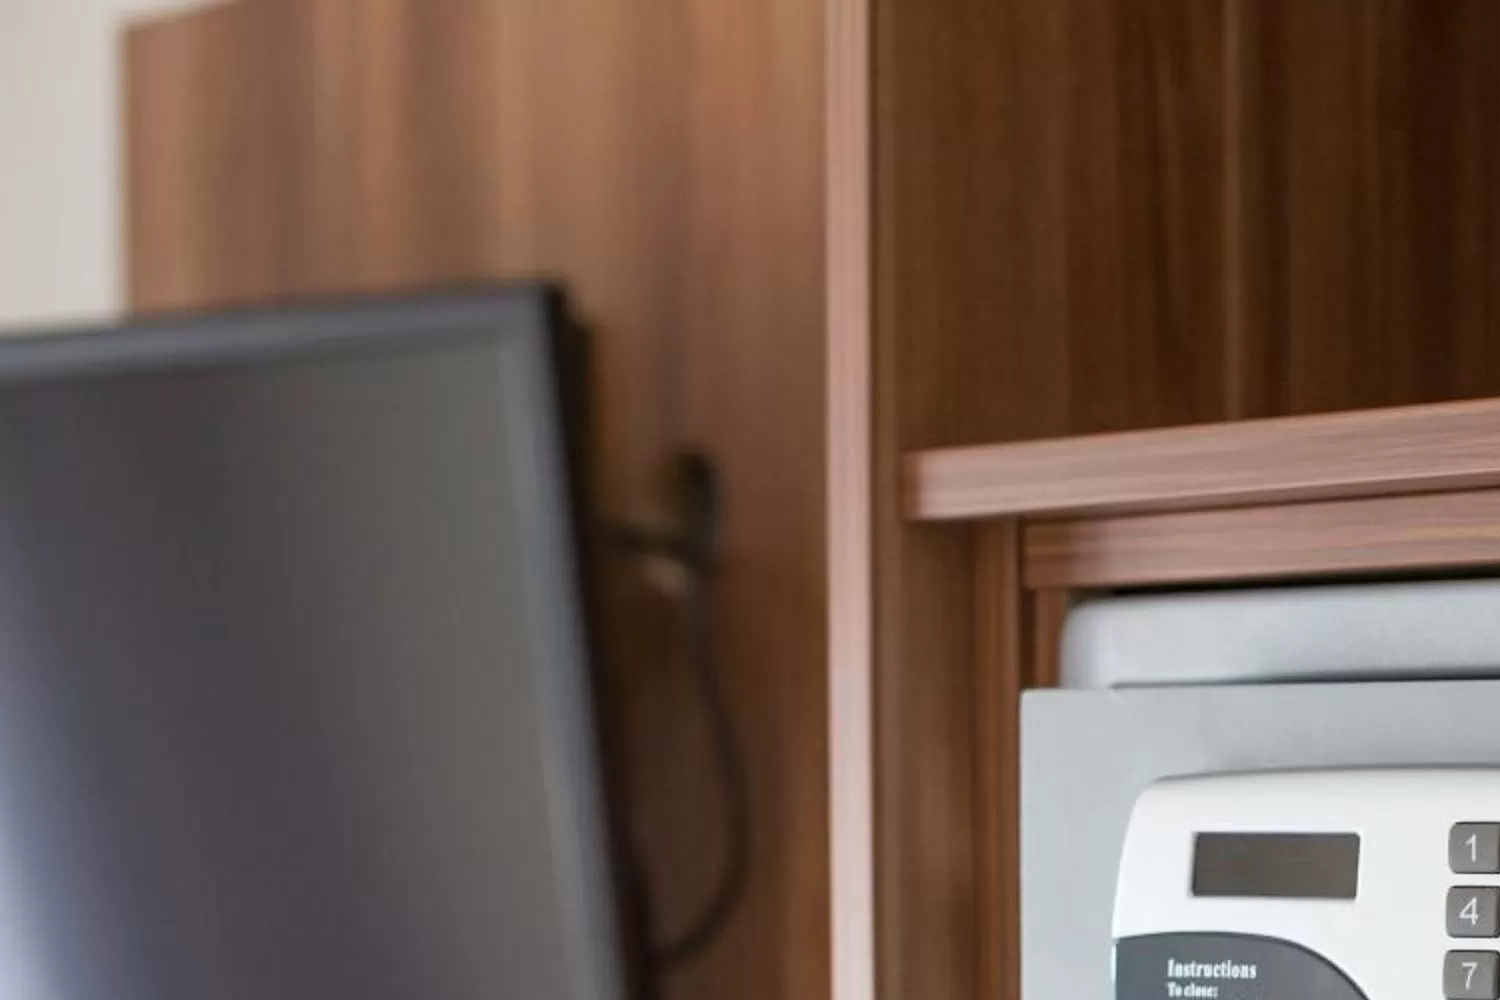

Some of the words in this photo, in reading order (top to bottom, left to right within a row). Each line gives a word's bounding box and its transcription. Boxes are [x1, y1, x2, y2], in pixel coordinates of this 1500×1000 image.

[1465, 833, 1477, 863] 1
[1459, 897, 1480, 926] 4
[1166, 958, 1257, 979] Instructions
[1461, 961, 1478, 991] 7
[1167, 981, 1182, 998] To
[1184, 982, 1219, 998] close:
